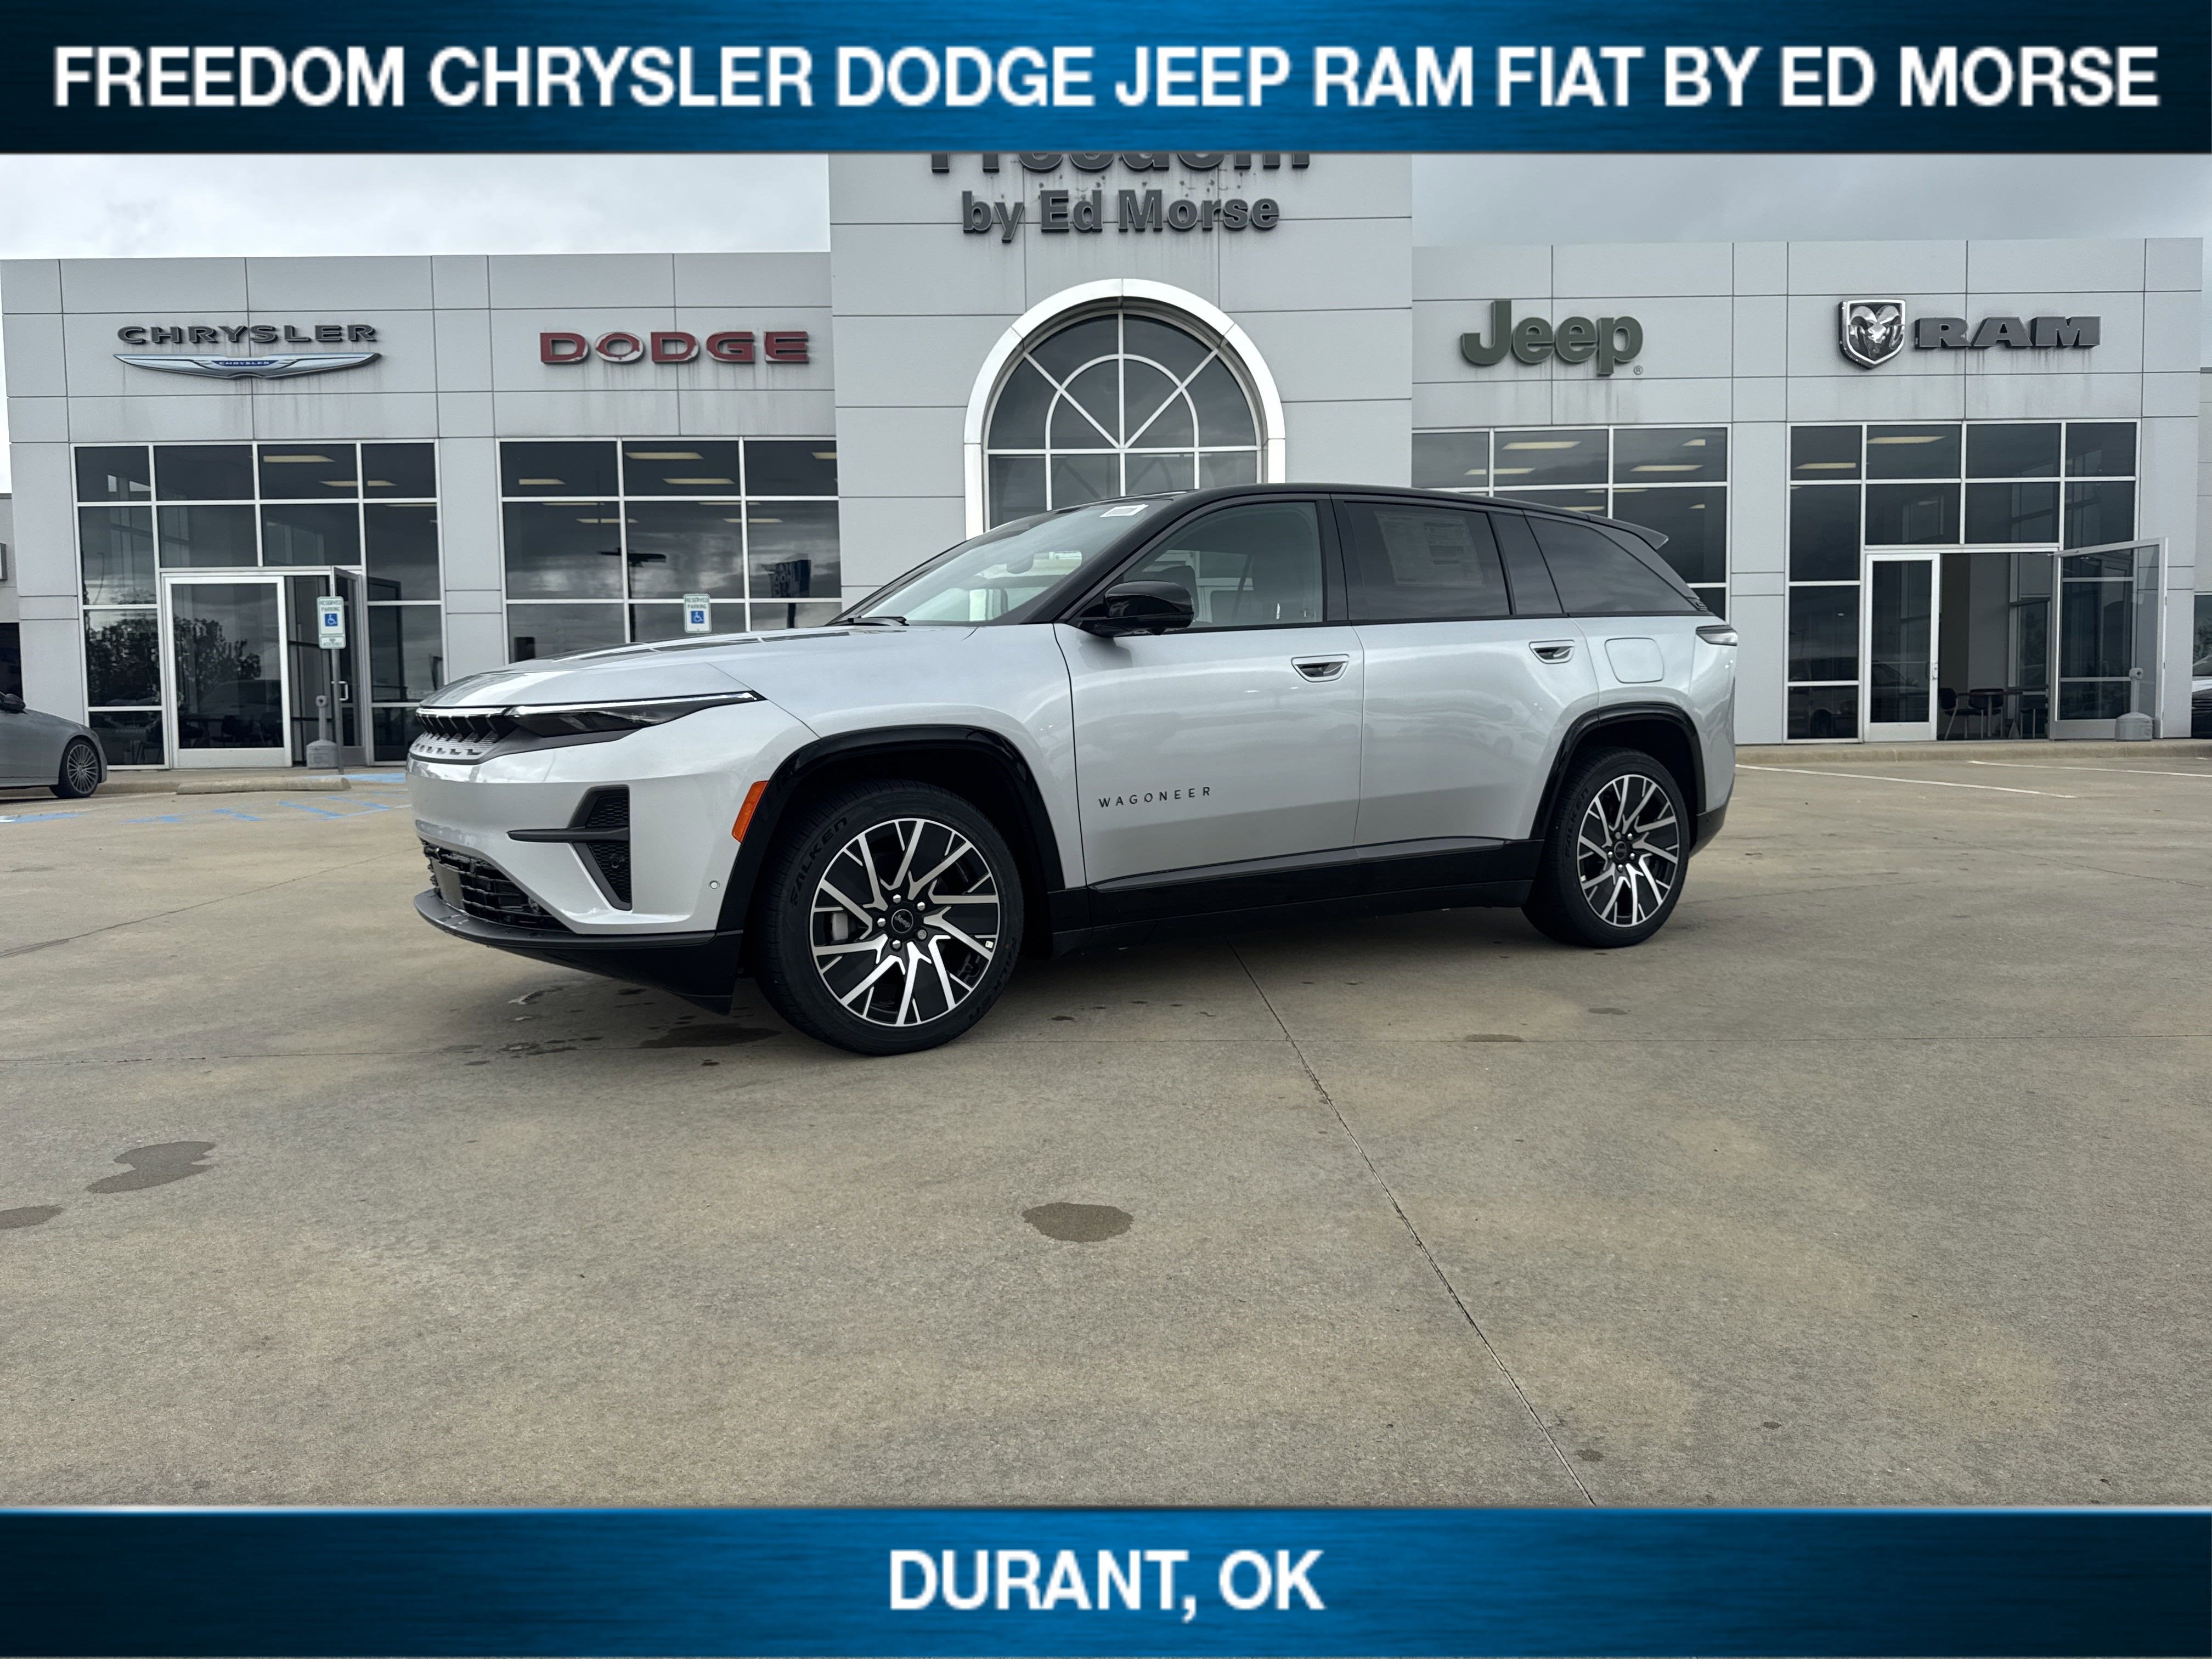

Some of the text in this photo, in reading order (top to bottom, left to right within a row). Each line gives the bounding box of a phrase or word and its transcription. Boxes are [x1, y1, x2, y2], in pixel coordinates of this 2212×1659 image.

[962, 189, 1280, 242] by Ed Morse
[117, 324, 377, 345] CHRYSLER
[540, 331, 809, 364] DODGE
[1460, 299, 1644, 377] Jeep
[1914, 315, 2101, 350] RAM
[1098, 787, 1211, 808] WAGONEER
[790, 816, 848, 906] FALKEN
